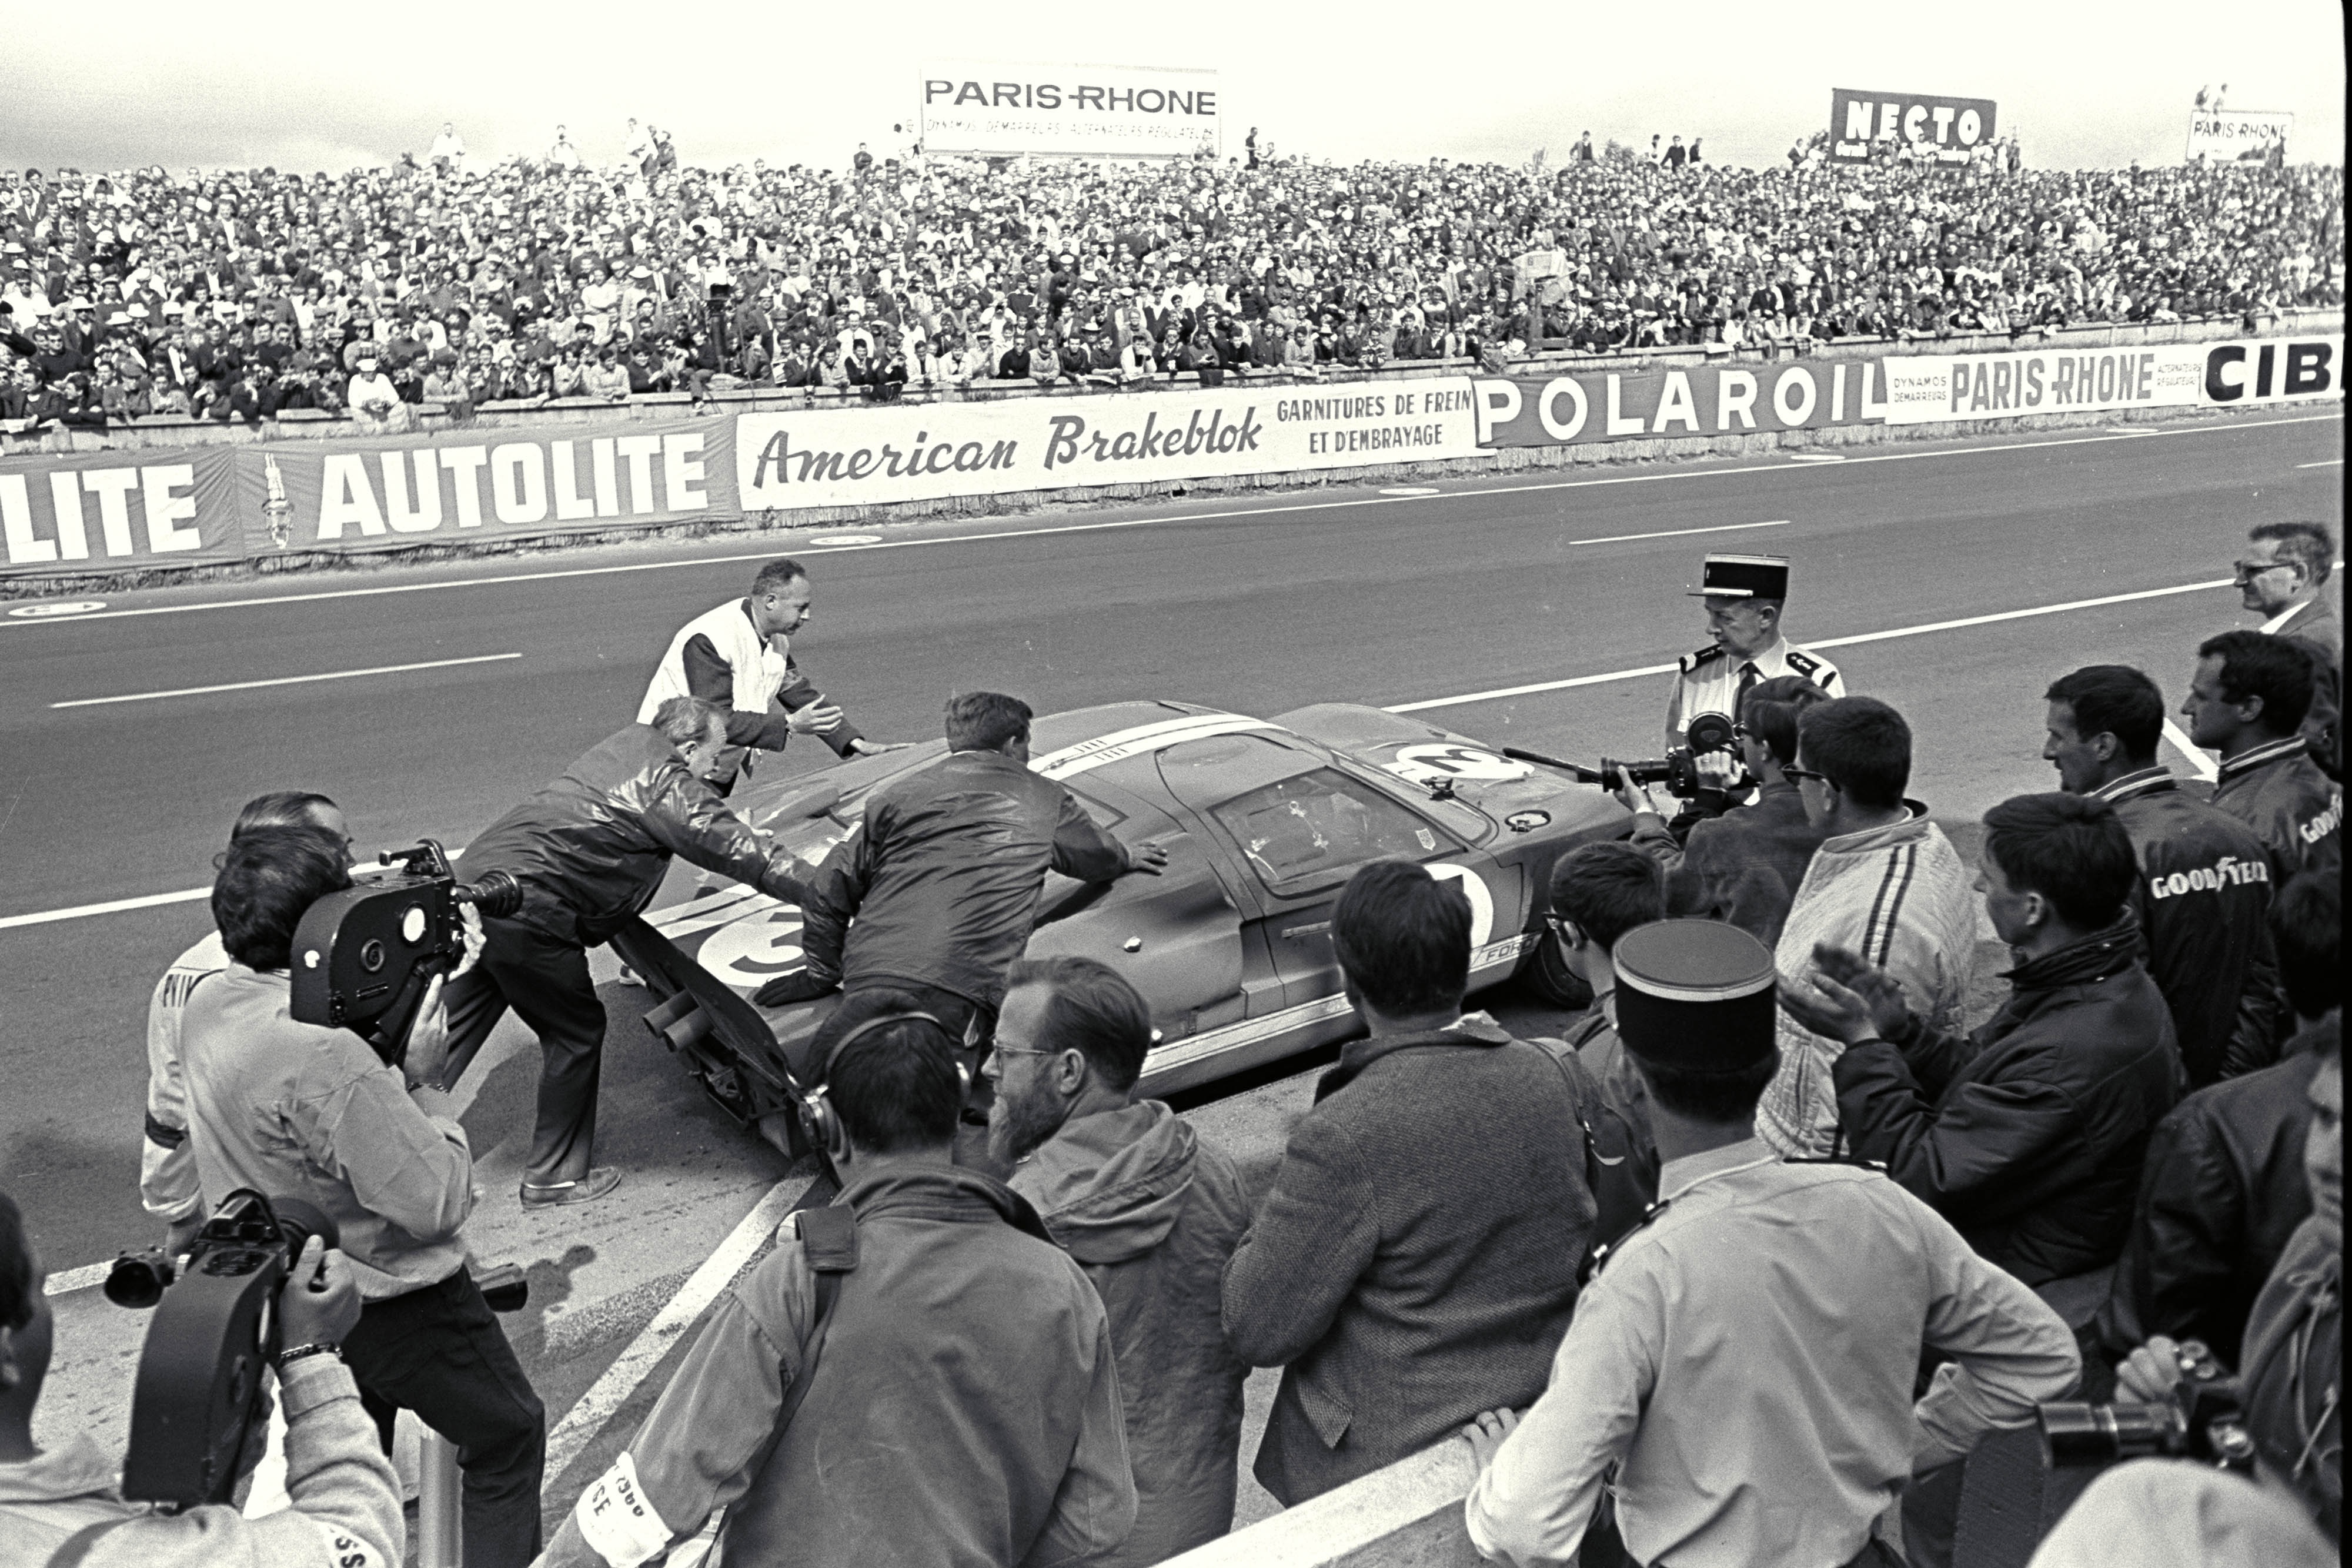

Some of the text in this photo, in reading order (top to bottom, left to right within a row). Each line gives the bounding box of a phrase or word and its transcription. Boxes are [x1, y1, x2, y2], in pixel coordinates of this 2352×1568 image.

[1845, 101, 1982, 145] NECTO
[1893, 376, 1947, 389] DYNAMOS
[2205, 342, 2333, 402] CIB
[1277, 389, 1472, 422] GARNITURES DE FREIN
[1474, 363, 1887, 443] POLAROIL
[753, 406, 1263, 489] American Brakeblok
[1309, 423, 1444, 454] ET D'EMBRAYAGE
[0, 464, 201, 563] LITE
[317, 433, 708, 539] AUTOLITE
